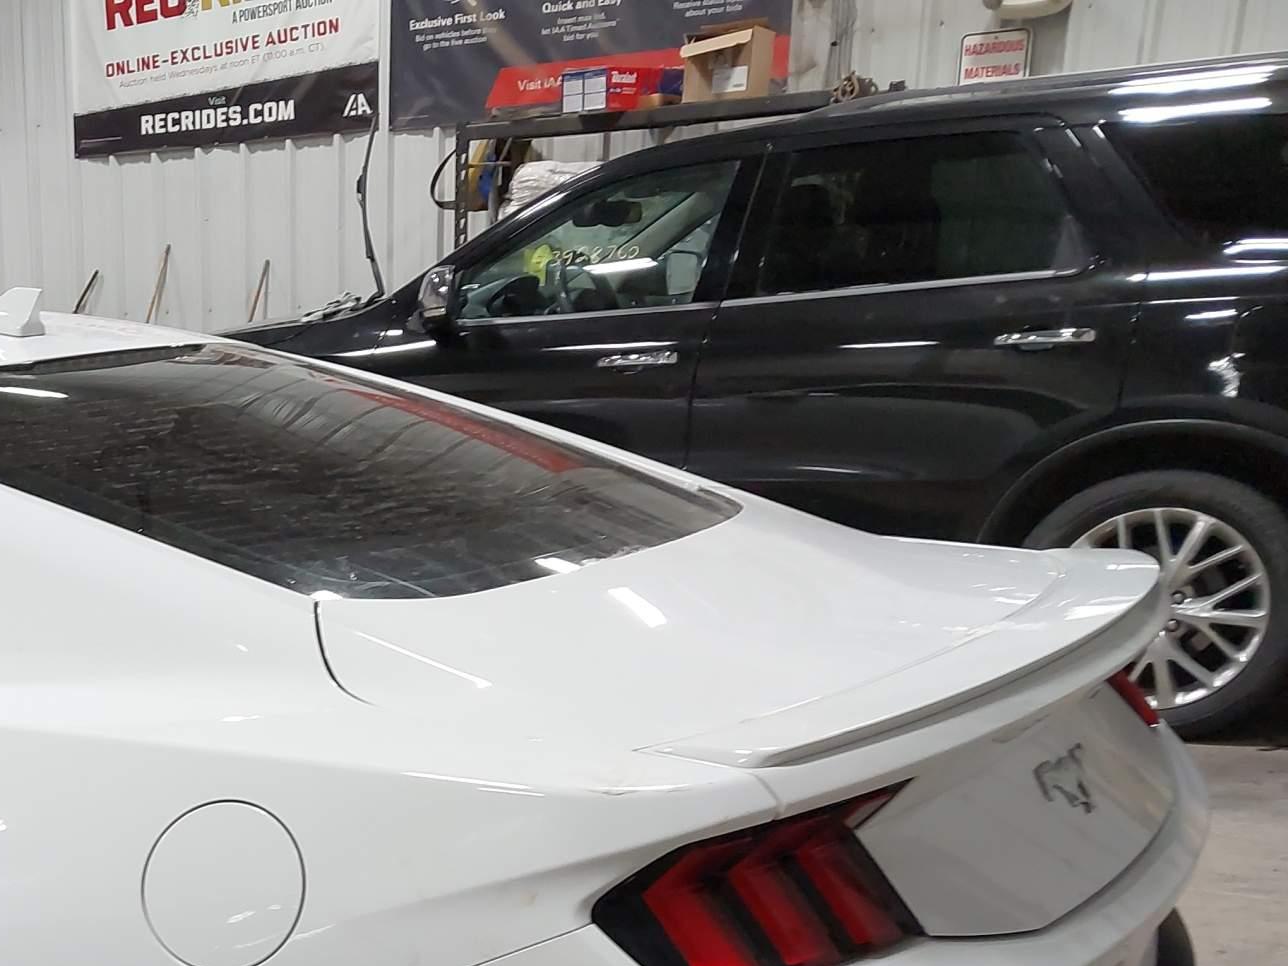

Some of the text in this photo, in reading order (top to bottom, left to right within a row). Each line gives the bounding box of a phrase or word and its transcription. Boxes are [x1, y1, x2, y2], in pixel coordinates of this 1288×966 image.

[232, 11, 239, 24] A
[239, 0, 293, 22] POWERSPORT
[542, 0, 574, 13] Quick
[575, 0, 596, 9] and
[409, 8, 506, 31] Exclusive First Look
[552, 26, 566, 34] IAA
[106, 17, 339, 78] ONLINE-EXCLUSIVE AUCTION
[964, 39, 1025, 57] HAZARDOUS
[119, 78, 147, 88] Auction
[168, 65, 218, 79] Wednesdays
[230, 58, 250, 68] noon
[964, 63, 1021, 80] MATERIALS
[517, 79, 541, 92] Visit
[207, 95, 227, 106] Visit
[140, 99, 296, 136] RECRIDES.COM
